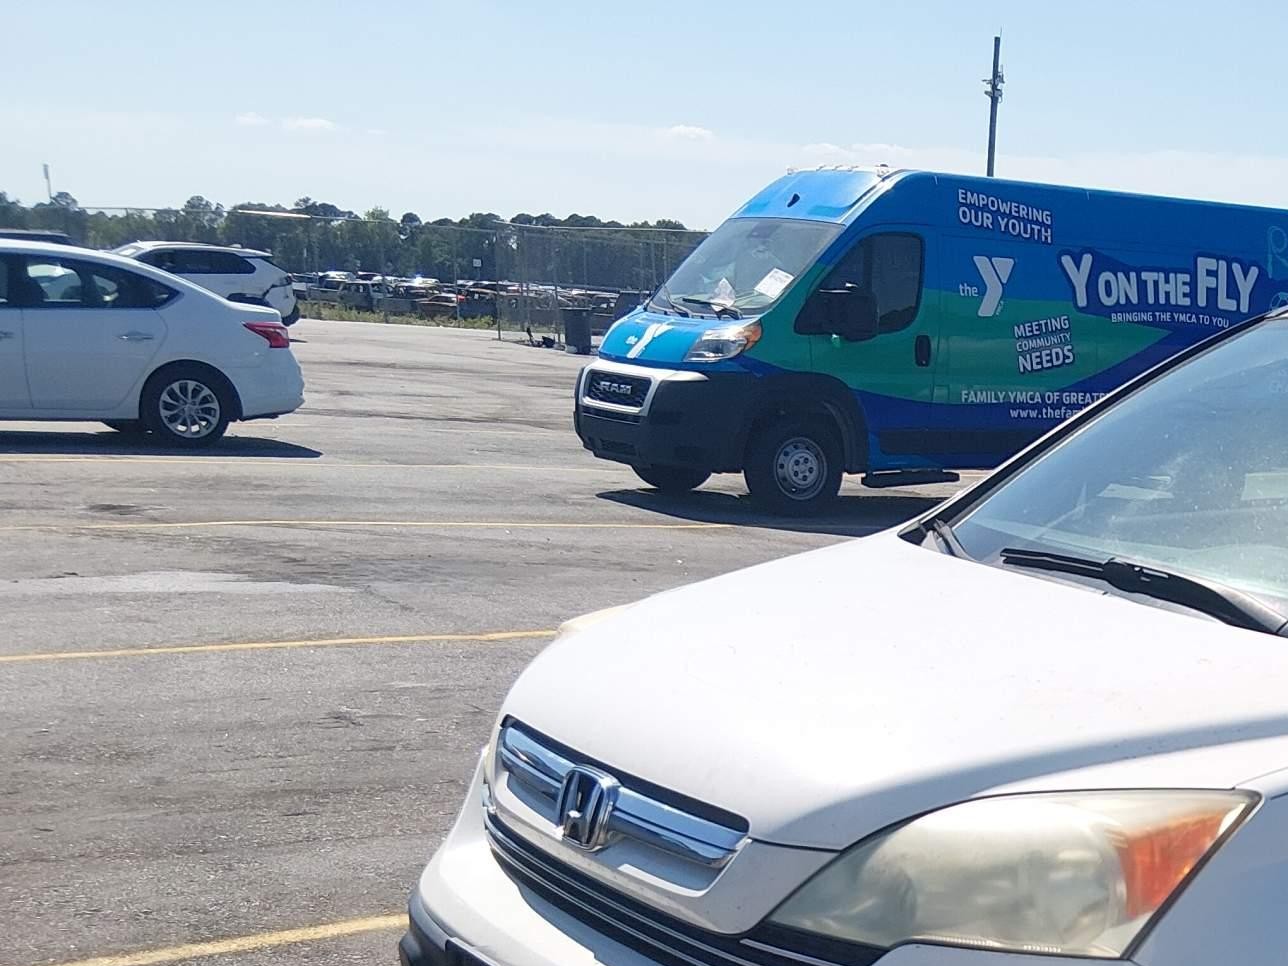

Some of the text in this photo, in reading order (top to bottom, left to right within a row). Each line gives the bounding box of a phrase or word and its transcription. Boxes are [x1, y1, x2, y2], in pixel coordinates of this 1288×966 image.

[958, 189, 1052, 225] EMPOWERING
[959, 206, 1052, 244] OUR YOUTH
[959, 283, 978, 297] the
[1061, 253, 1259, 314] Y ON THE FLY
[1014, 315, 1070, 339] MEETING
[1111, 312, 1230, 329] BRINGING THE YMCA TO YOU
[1016, 332, 1071, 352] COMMUNITY
[1018, 345, 1074, 373] NEEDS
[600, 381, 632, 394] RAM
[961, 391, 1006, 403] FAMILY
[1008, 391, 1042, 404] YMCA
[1045, 392, 1061, 404] OF
